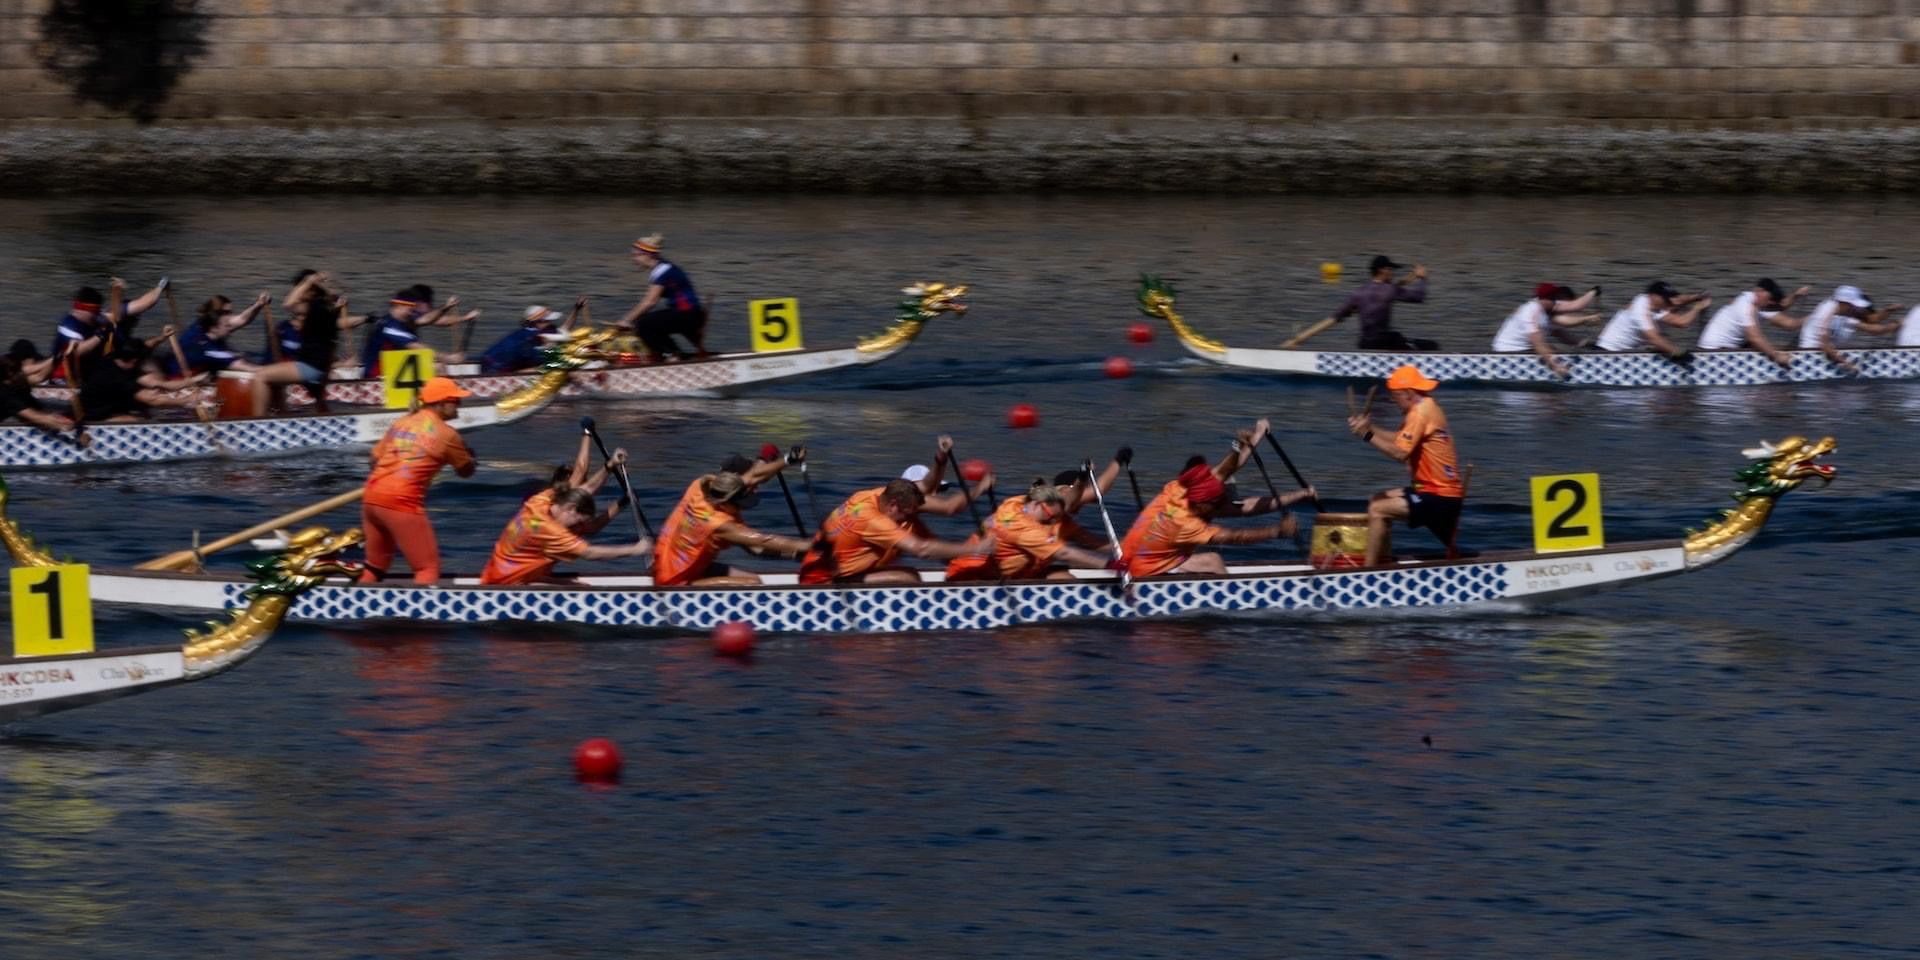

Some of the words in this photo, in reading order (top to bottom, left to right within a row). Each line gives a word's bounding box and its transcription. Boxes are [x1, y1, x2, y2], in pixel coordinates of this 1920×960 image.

[762, 303, 789, 343] 5
[394, 354, 425, 399] 4
[1546, 479, 1589, 538] 2
[29, 571, 64, 639] 1
